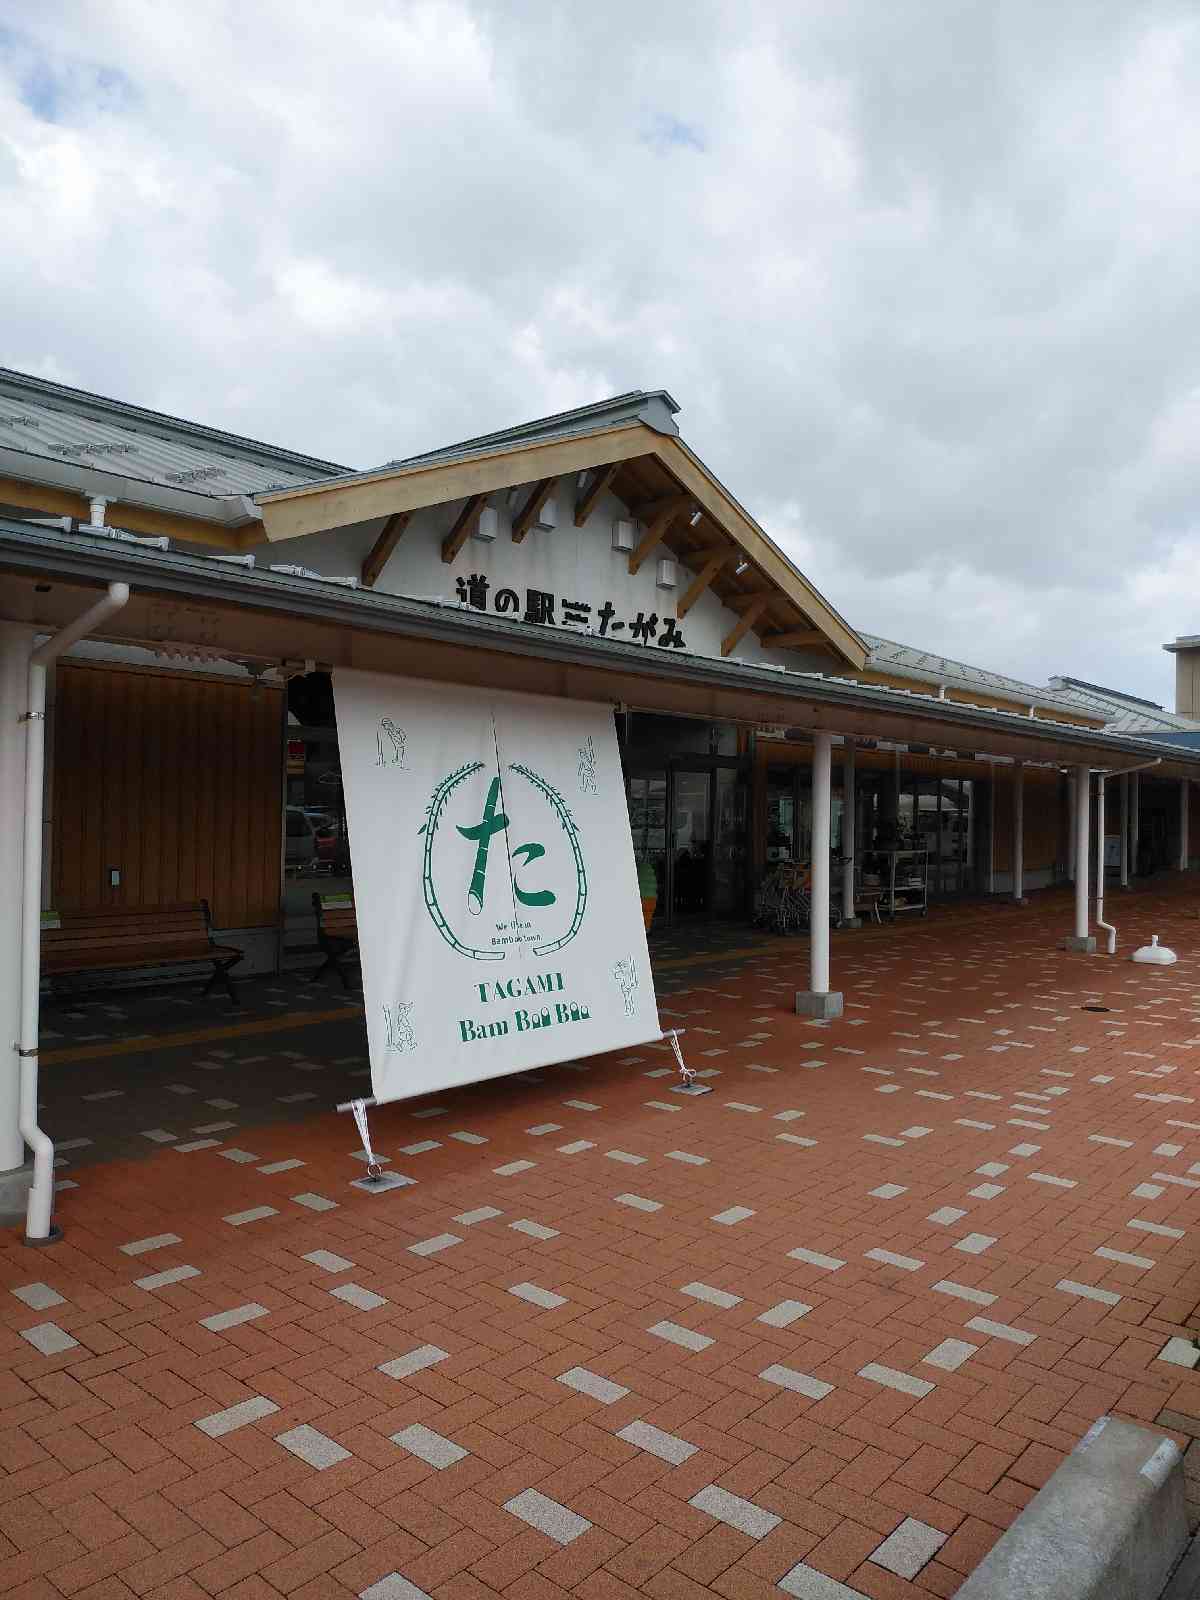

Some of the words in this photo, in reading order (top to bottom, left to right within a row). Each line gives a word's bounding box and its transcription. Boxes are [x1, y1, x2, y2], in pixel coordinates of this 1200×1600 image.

[455, 573, 556, 625] 道の駅
[597, 601, 687, 649] たがみ
[455, 776, 557, 916] た
[473, 972, 565, 1003] TAGAMI
[456, 1019, 509, 1043] Bam
